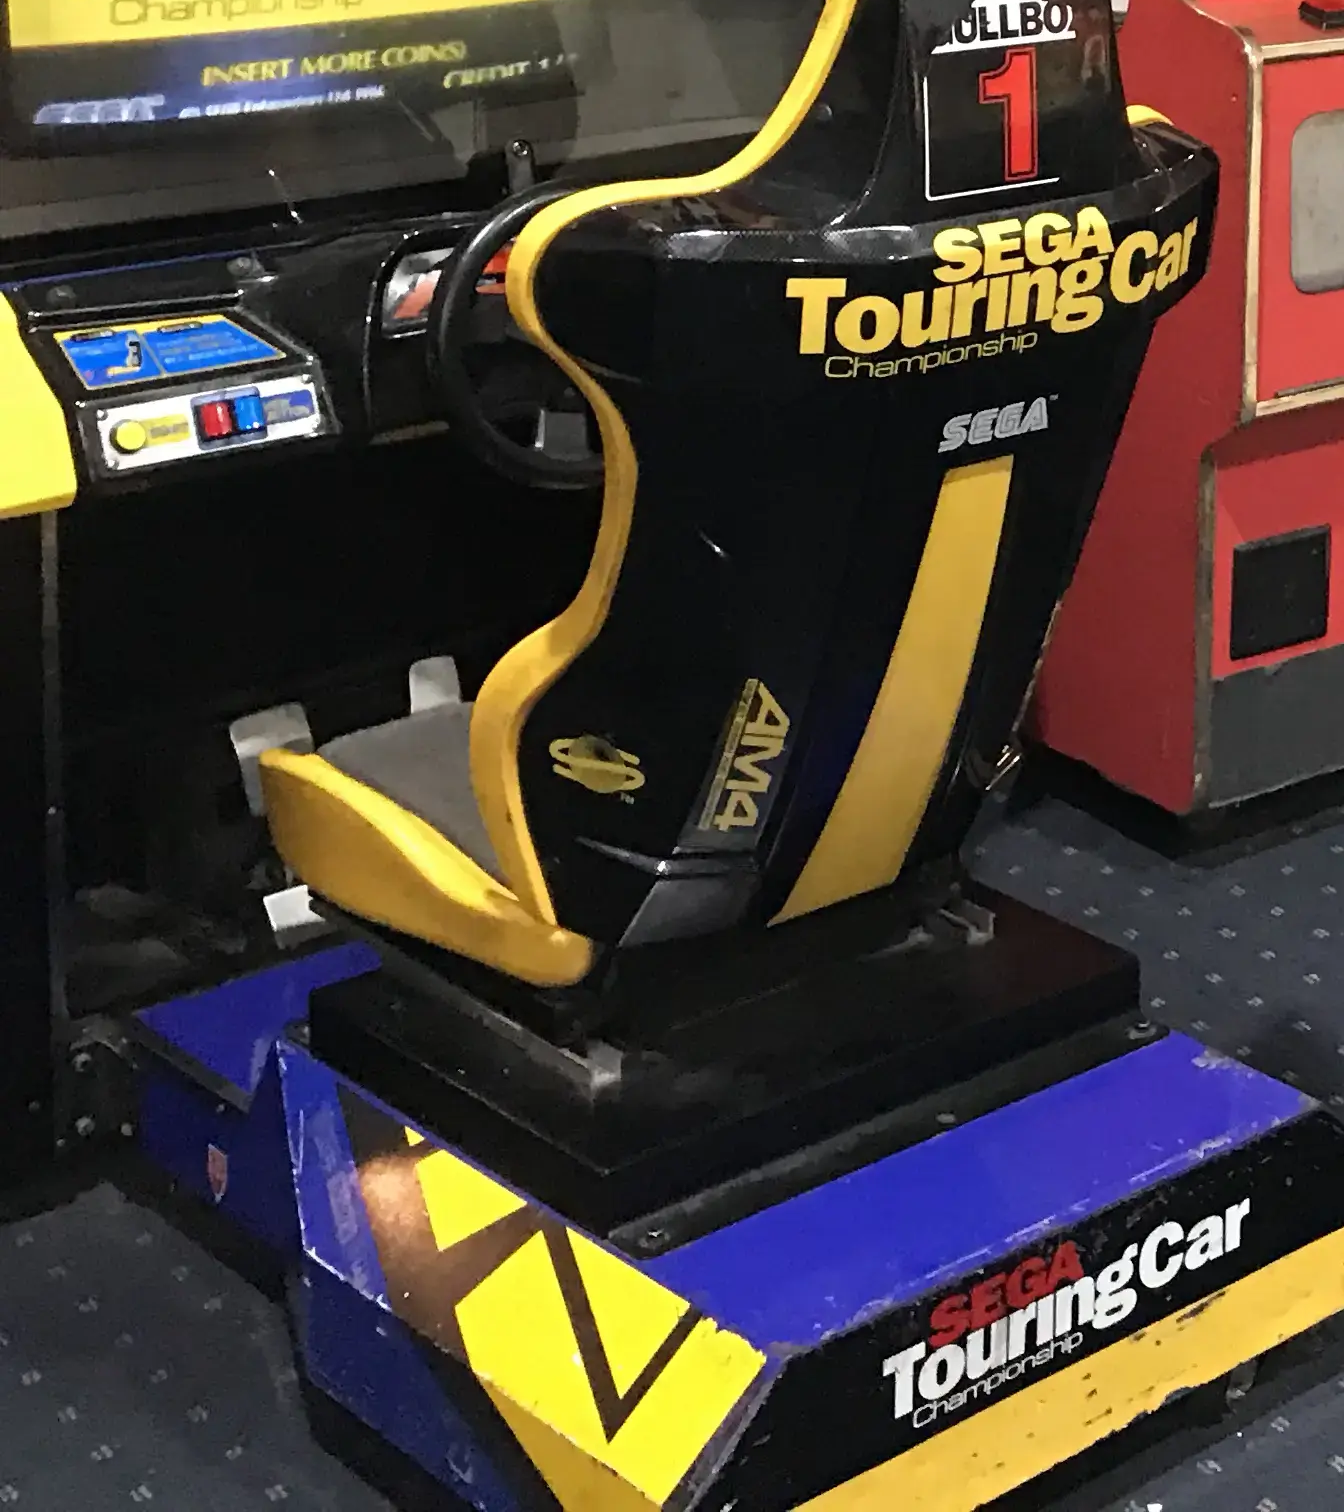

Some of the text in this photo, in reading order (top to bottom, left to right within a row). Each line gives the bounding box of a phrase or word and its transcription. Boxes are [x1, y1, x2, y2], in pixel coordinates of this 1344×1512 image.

[202, 58, 294, 86] INSERT
[301, 50, 376, 76] MORE
[978, 45, 1038, 183] 1
[933, 206, 1115, 284] SEGA
[824, 329, 1038, 379] Championship
[938, 396, 1050, 454] SEGA
[713, 682, 790, 831] AM4
[929, 1240, 1085, 1348] SEGA
[912, 1330, 1084, 1429] Championship
